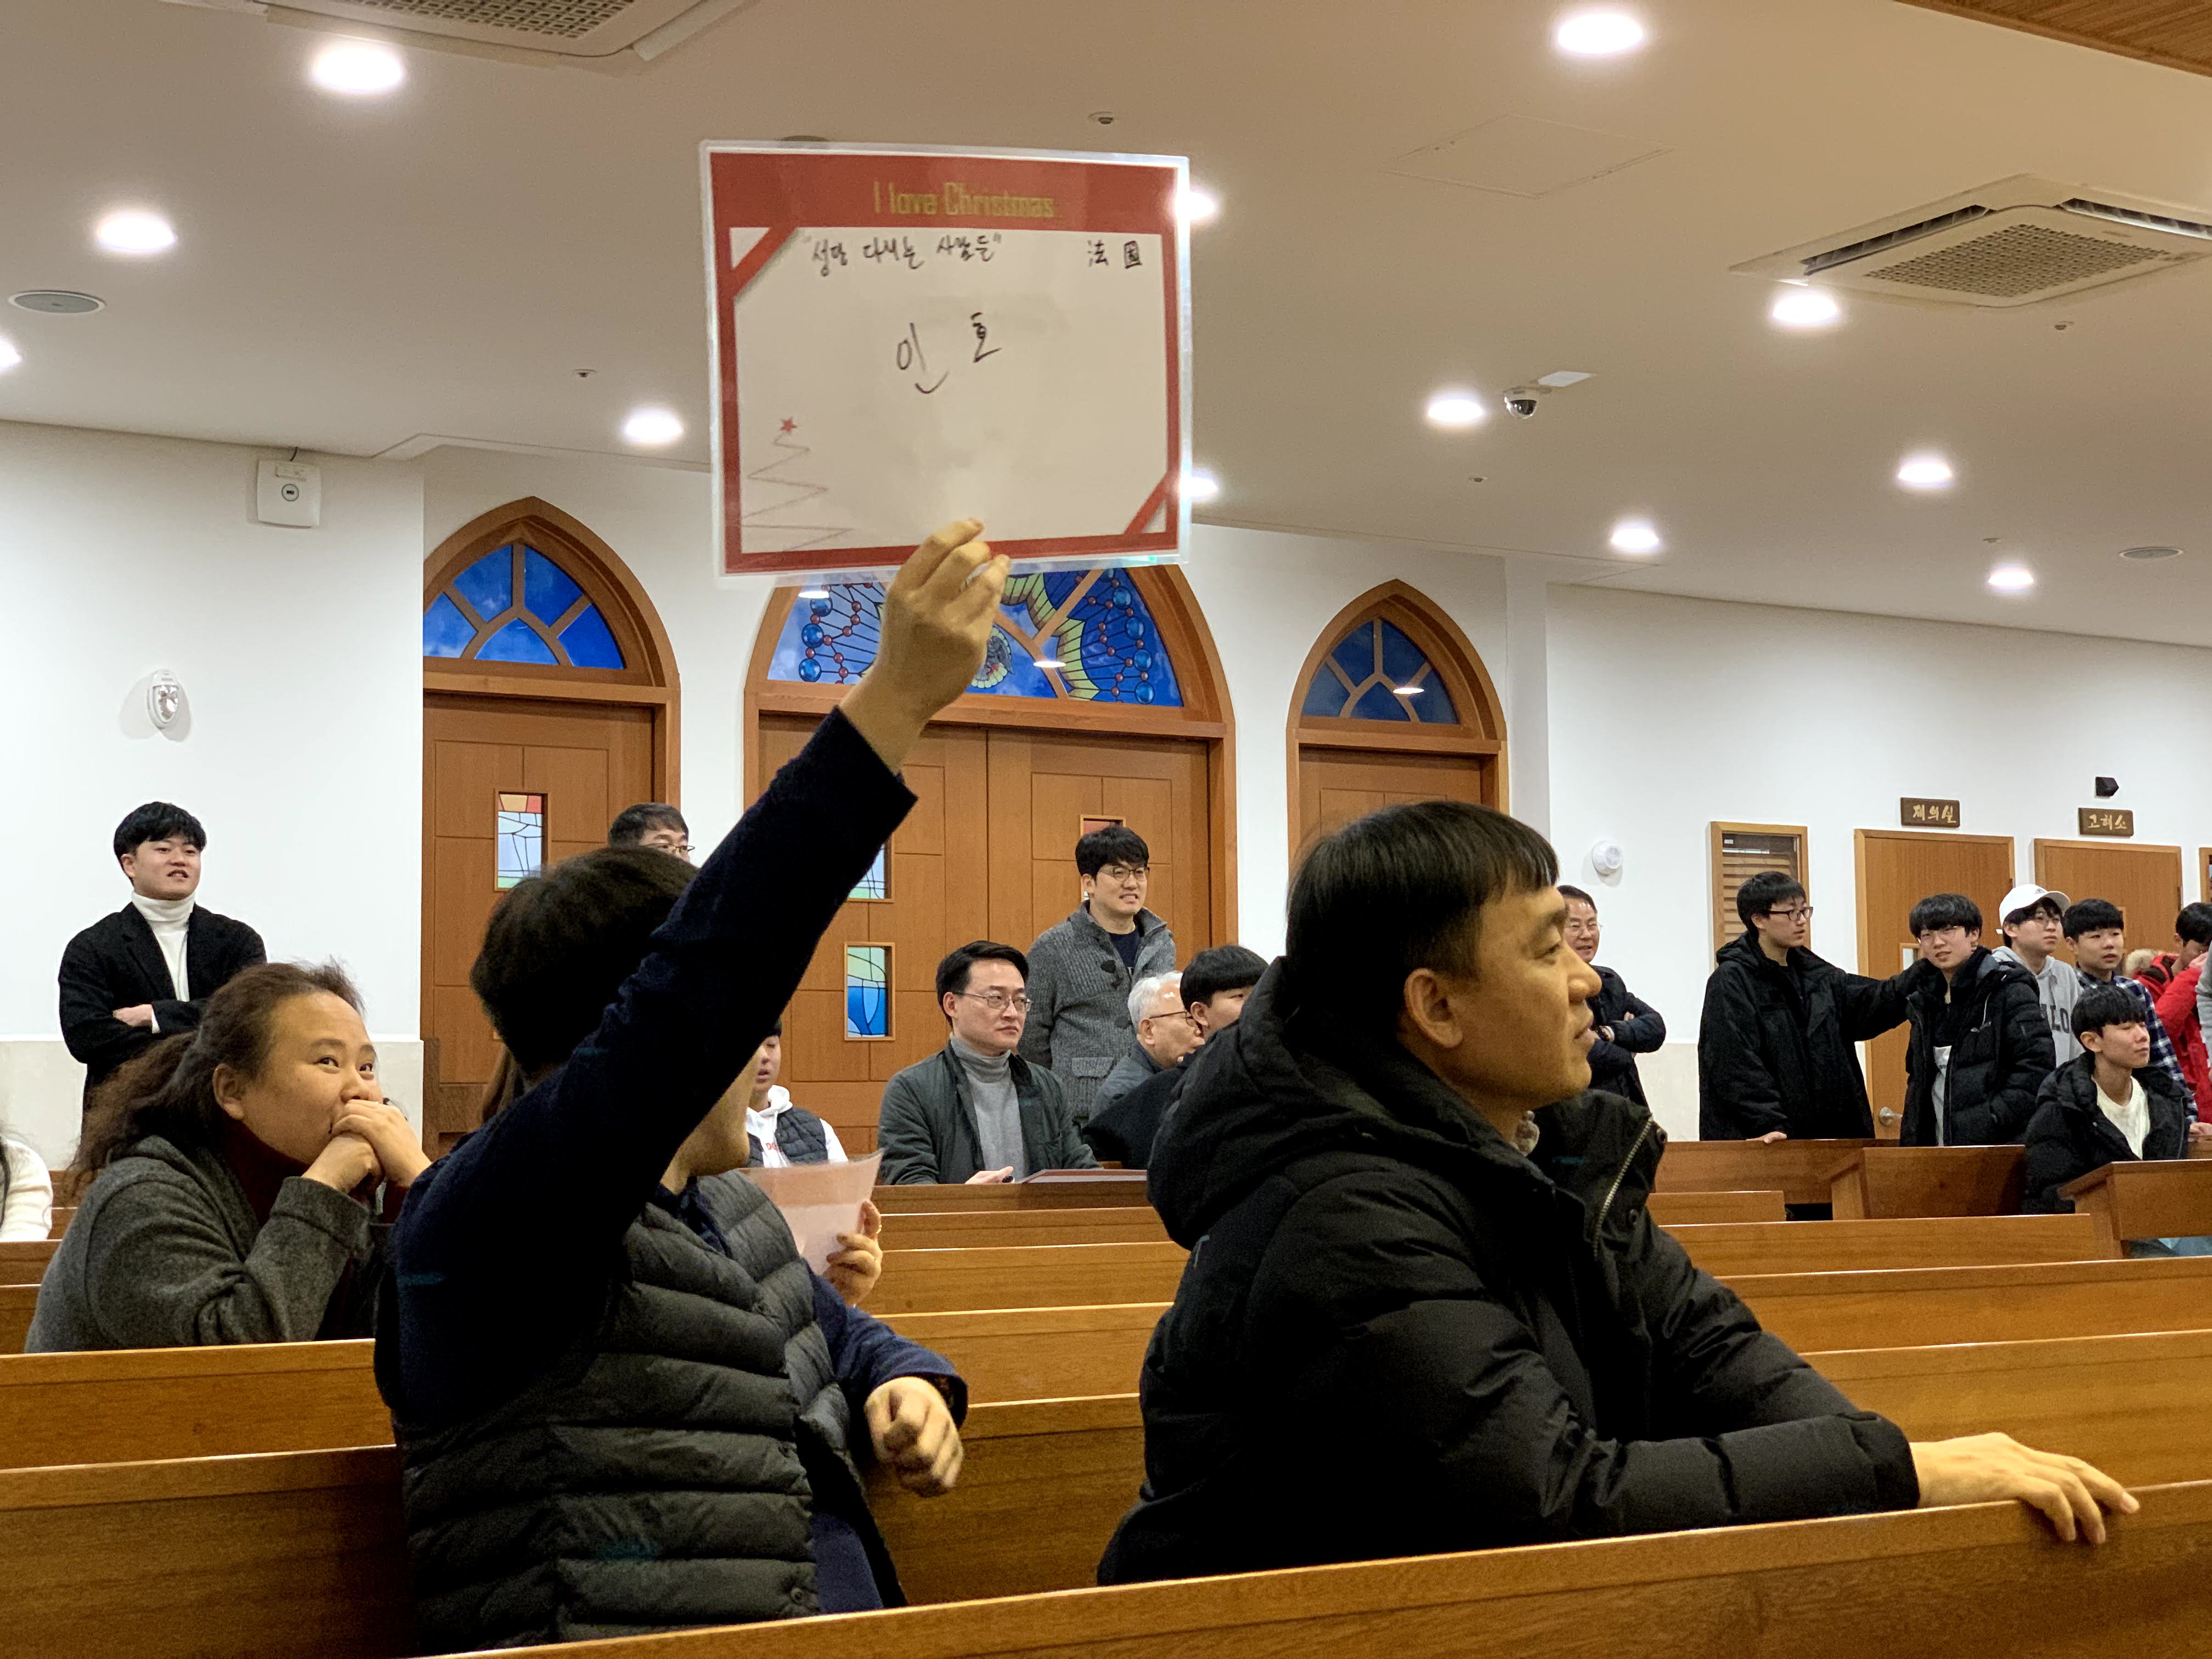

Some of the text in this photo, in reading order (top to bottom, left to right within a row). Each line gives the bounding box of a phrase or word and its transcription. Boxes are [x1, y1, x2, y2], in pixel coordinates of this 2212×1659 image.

[873, 180, 1054, 218] I love Christmas
[1912, 804, 1957, 823] 제의실
[2087, 814, 2128, 831] 고해소
